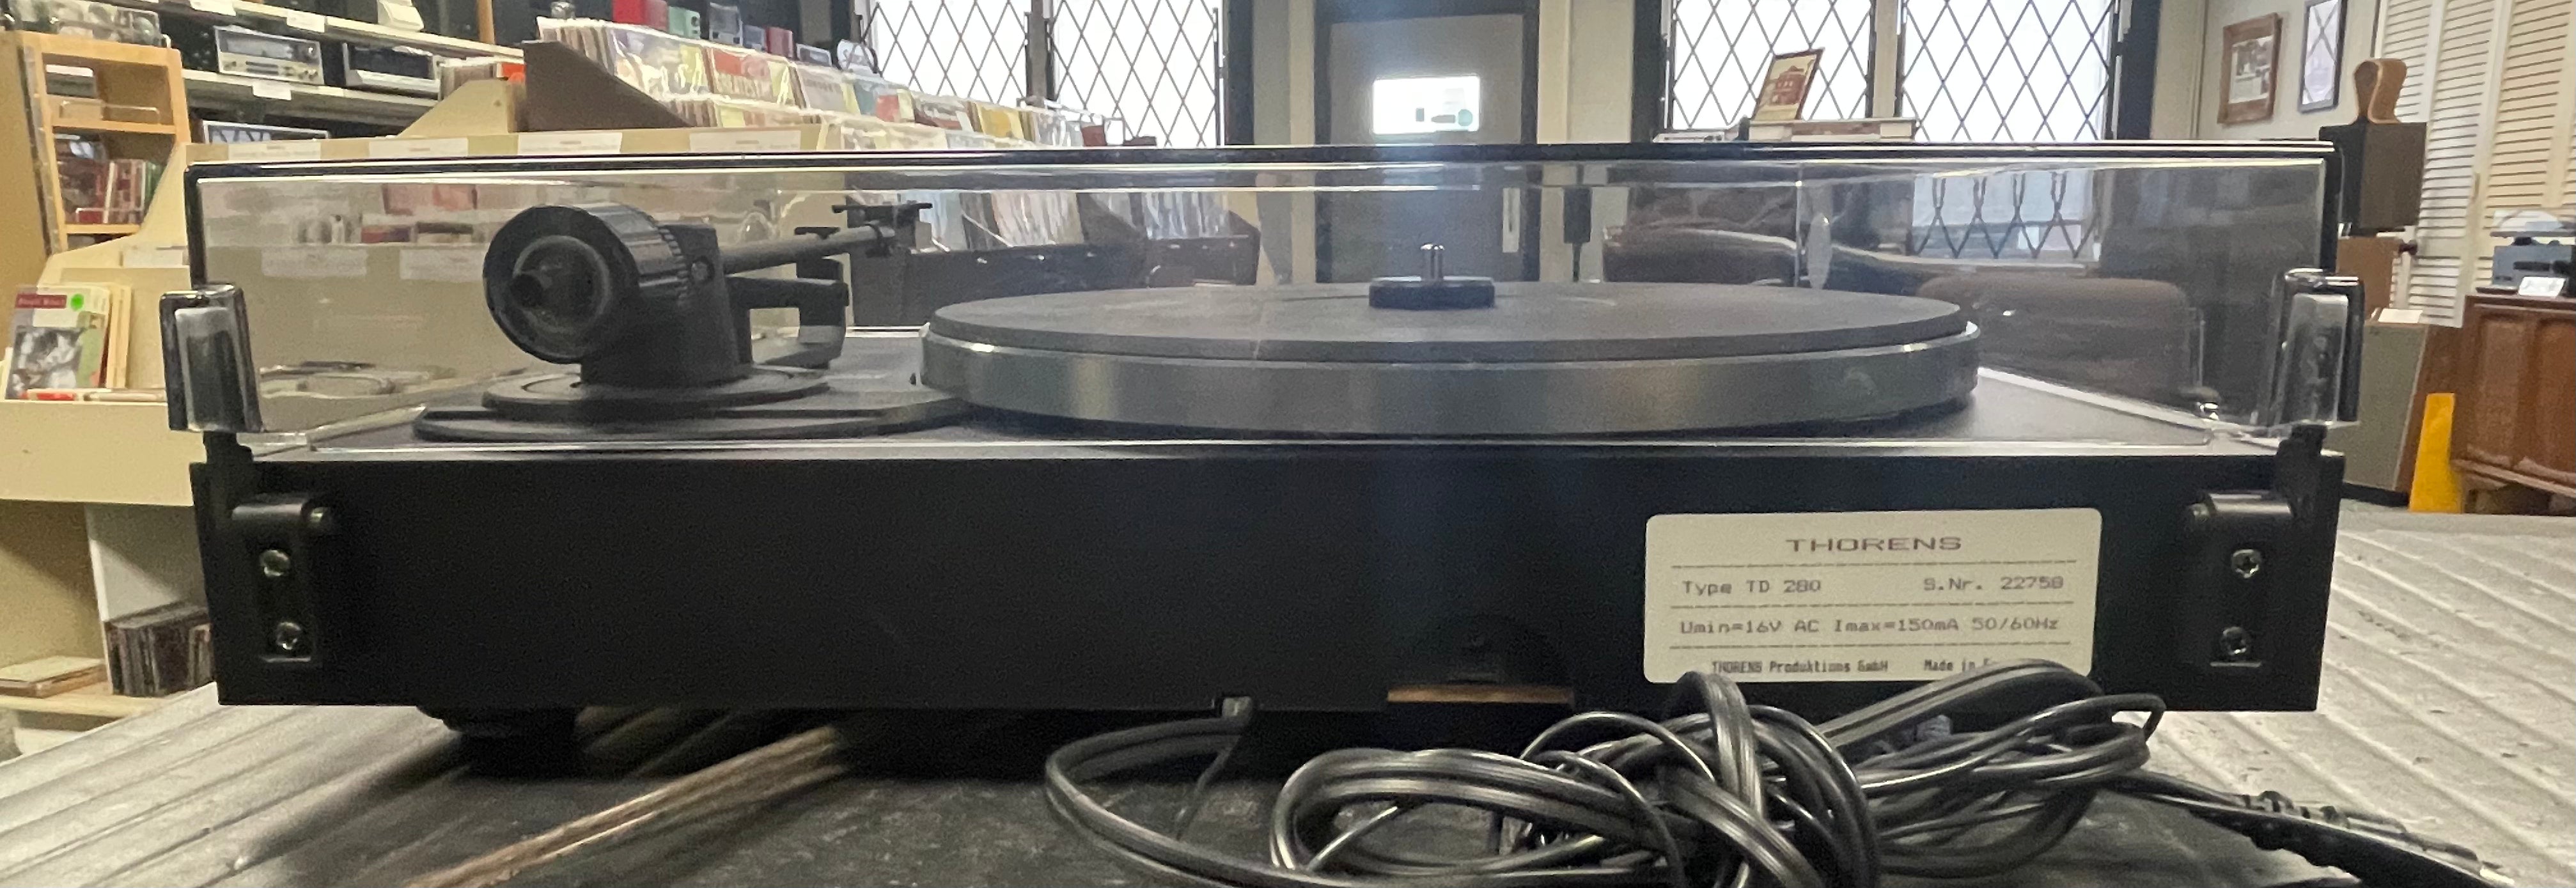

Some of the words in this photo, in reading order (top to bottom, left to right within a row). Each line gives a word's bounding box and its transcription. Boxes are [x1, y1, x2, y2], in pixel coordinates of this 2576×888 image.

[1785, 536, 1962, 553] THORENS
[1682, 580, 1733, 596] Type
[1745, 579, 1770, 593] TD
[1783, 579, 1822, 593] 280
[1923, 577, 1983, 591] S.Nr.
[1680, 620, 1782, 634] Umin=16V
[1794, 619, 1820, 633] AC
[1834, 617, 1959, 632] Imax=150mA
[1971, 616, 2059, 631] 50/60Hz
[1712, 660, 1763, 674] THORENS
[1923, 658, 1954, 672] Made
[1962, 658, 1976, 672] in
